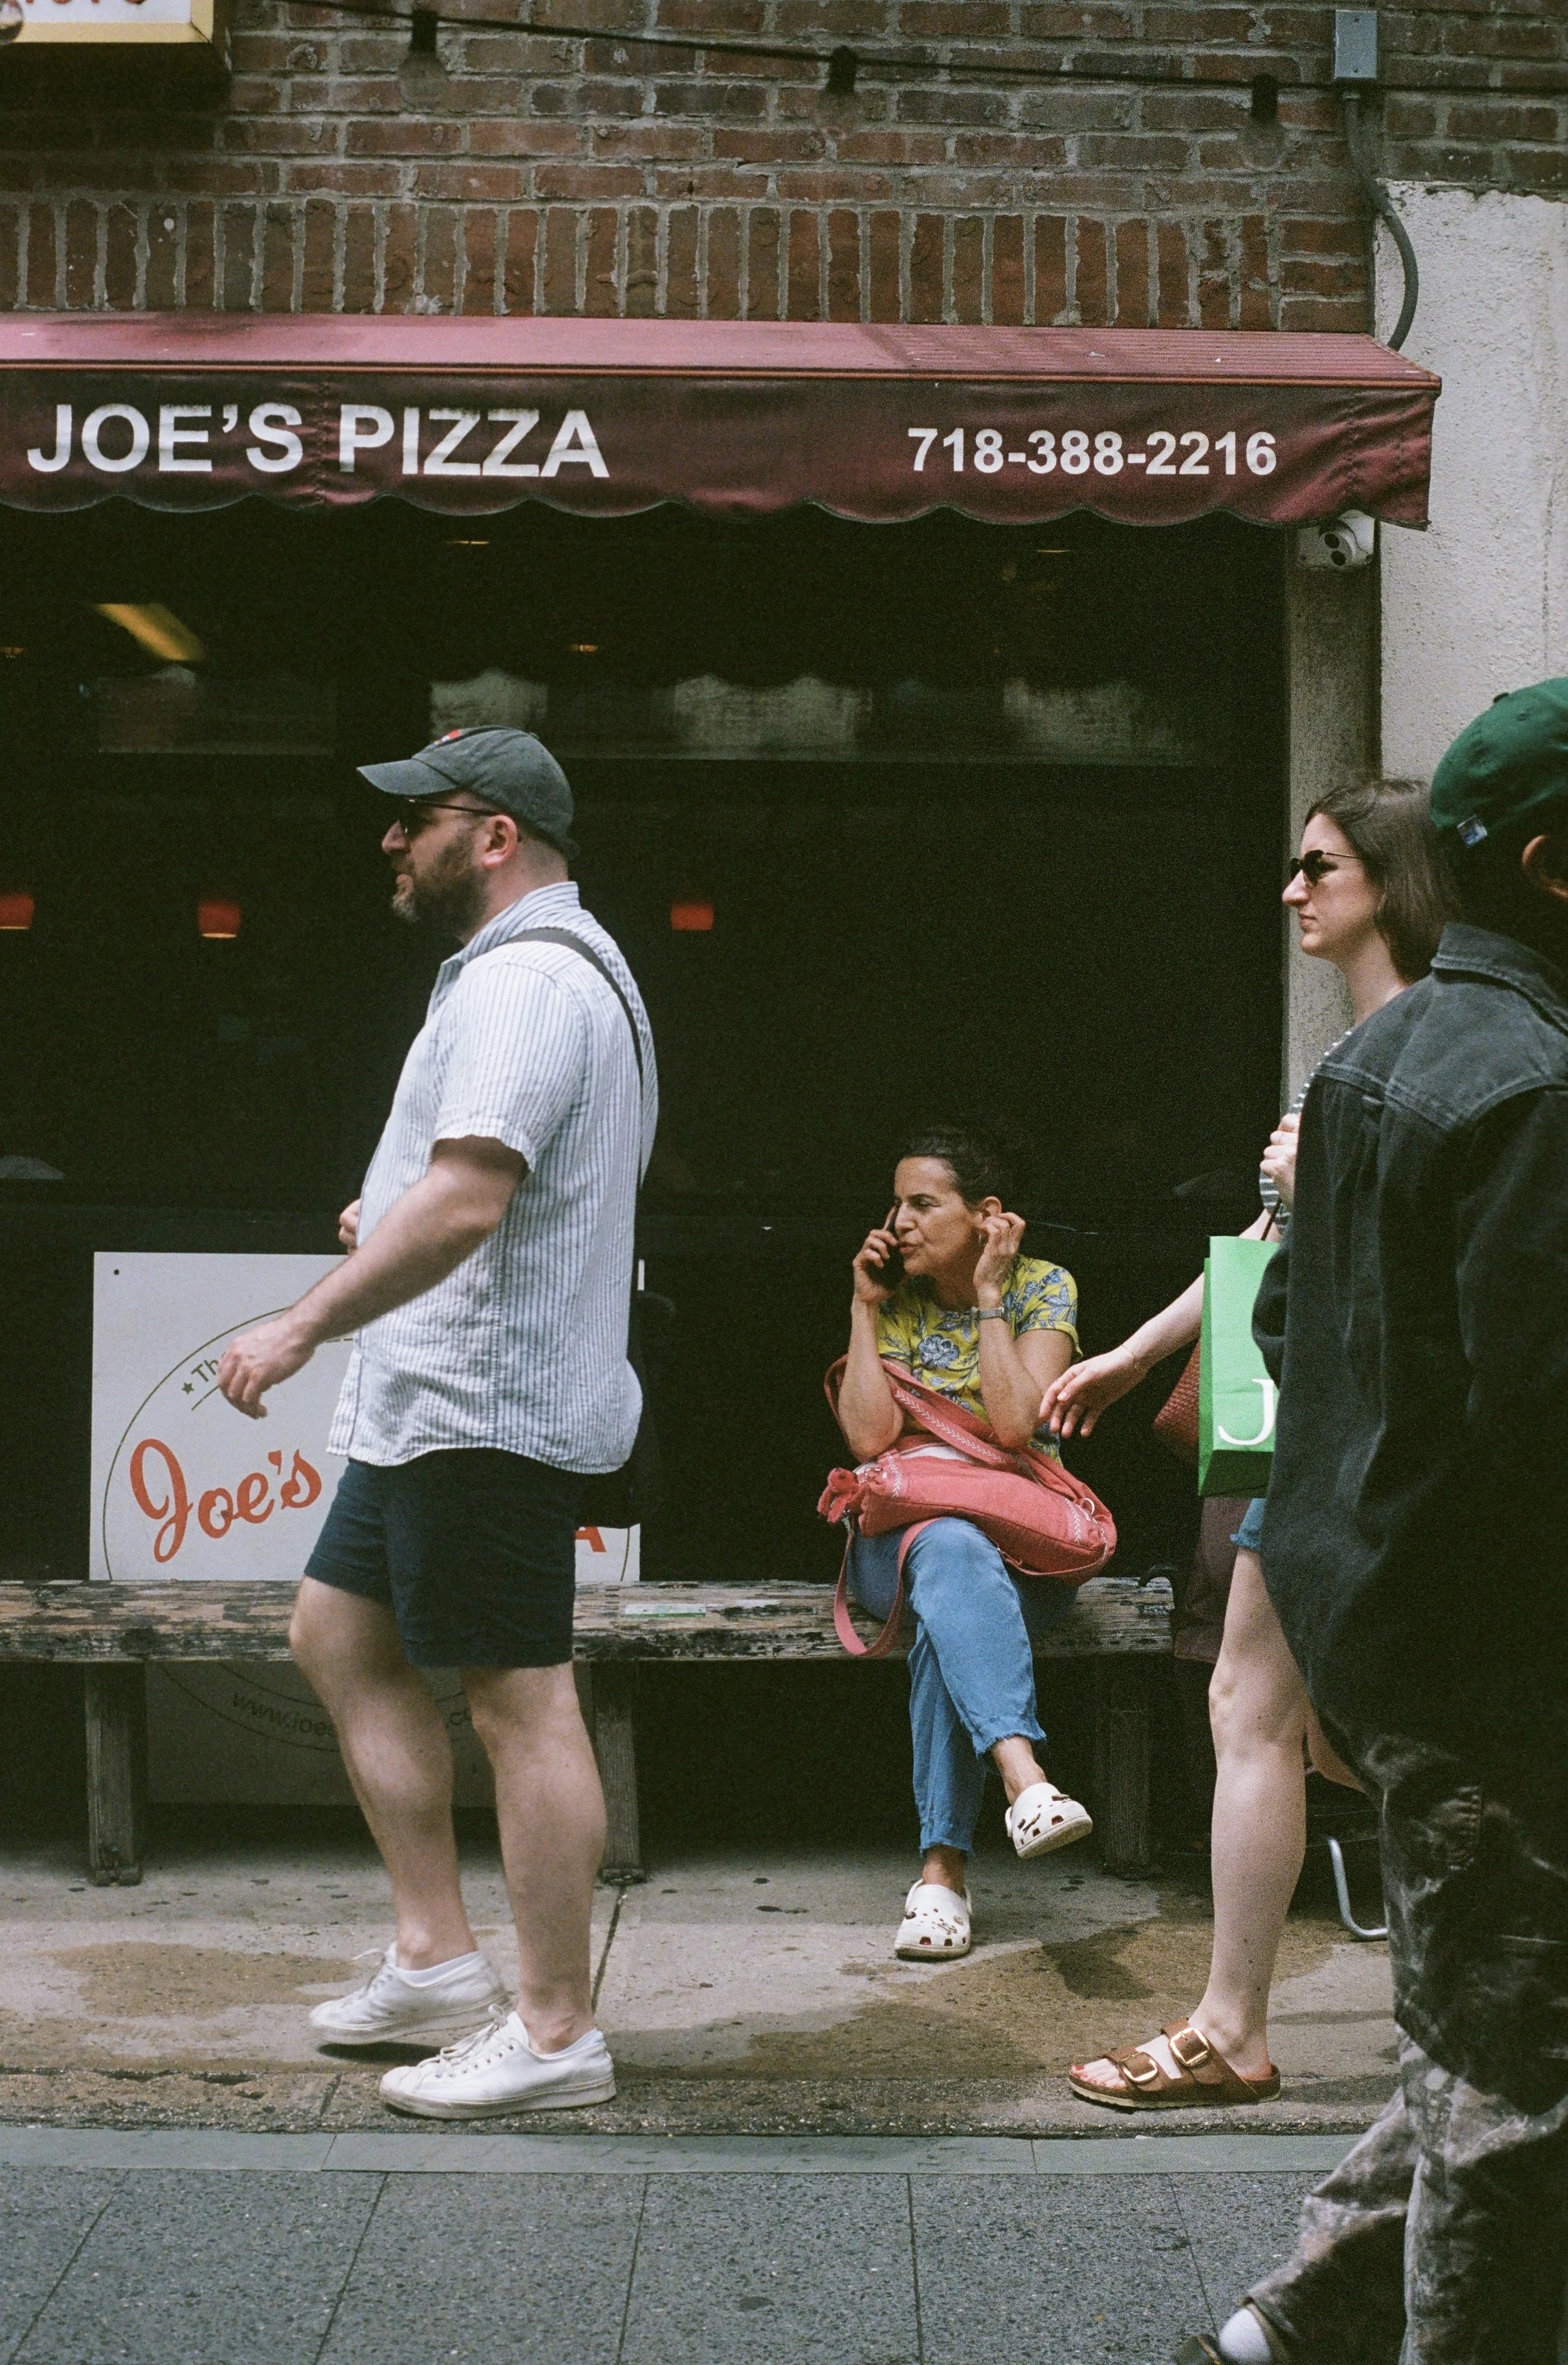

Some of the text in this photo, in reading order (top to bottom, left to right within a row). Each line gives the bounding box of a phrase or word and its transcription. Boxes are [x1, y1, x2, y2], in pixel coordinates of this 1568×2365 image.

[27, 402, 610, 478] JOE'S PIZZA
[908, 428, 1277, 476] 718-388-2216
[191, 1359, 219, 1382] Th
[130, 1438, 322, 1563] Joe's
